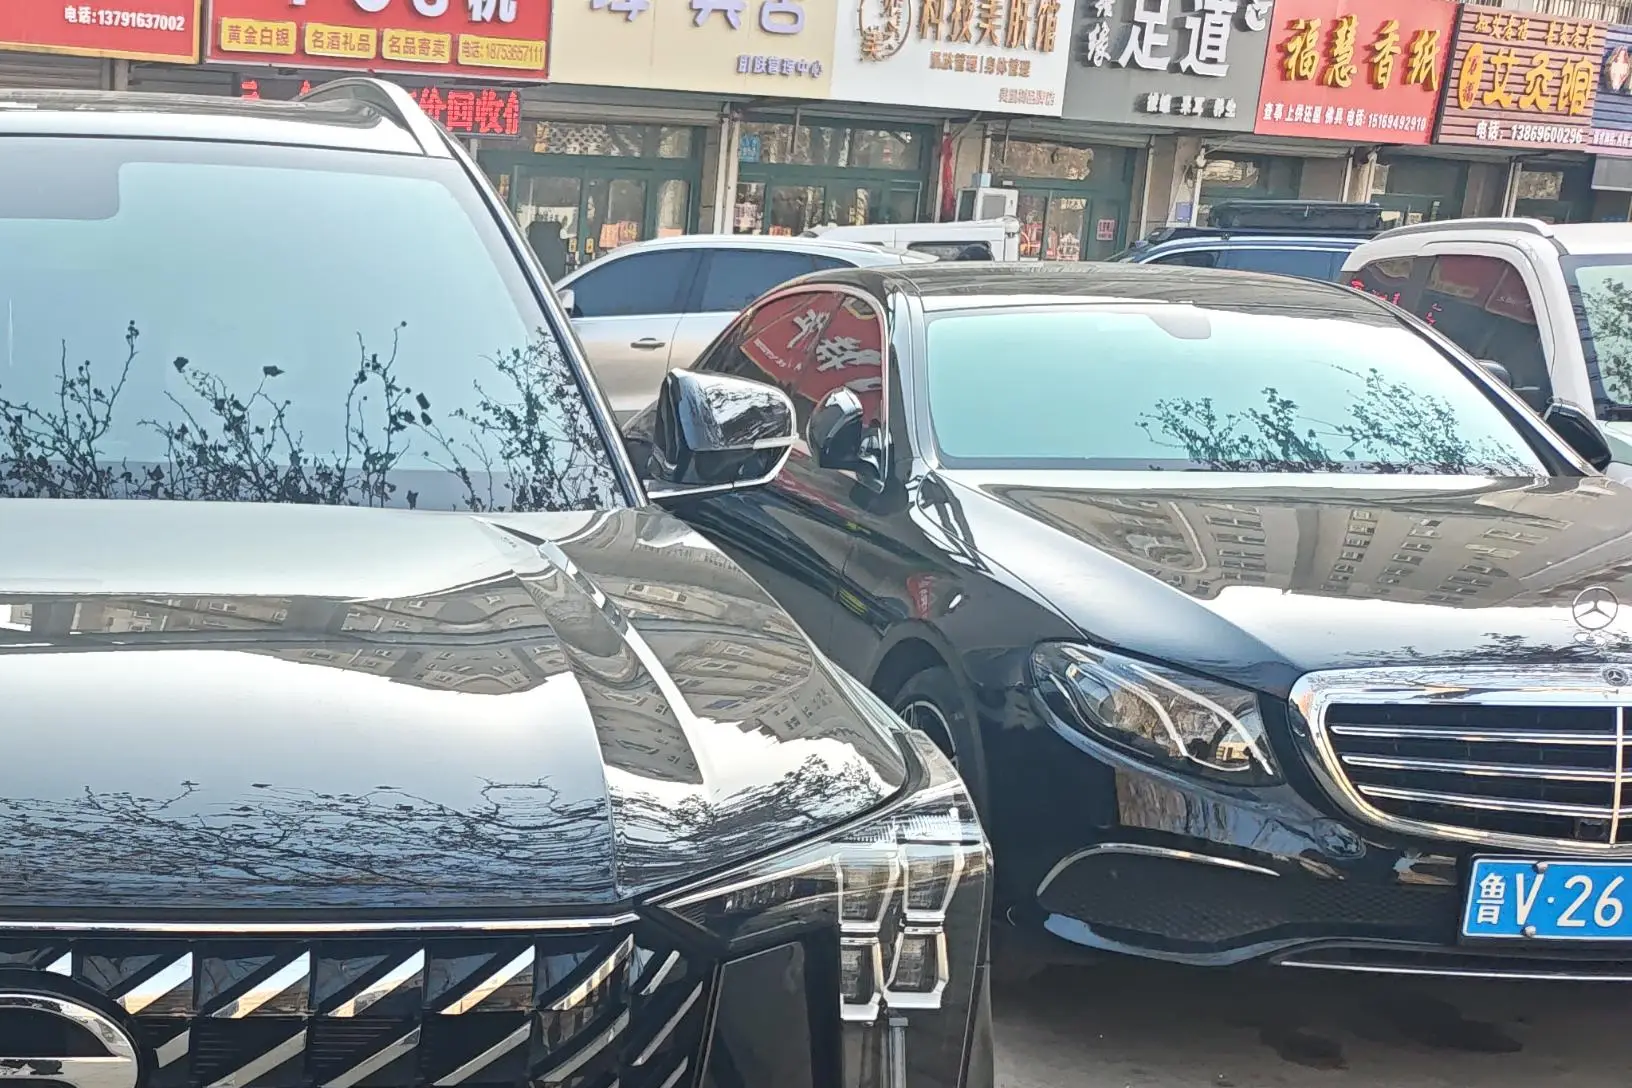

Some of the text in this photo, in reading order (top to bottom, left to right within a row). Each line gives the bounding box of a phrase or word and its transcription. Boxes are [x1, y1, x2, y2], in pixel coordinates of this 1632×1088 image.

[64, 5, 185, 31] 电话:13791637002
[227, 25, 289, 47] 黄金白银
[311, 30, 371, 53] 名酒礼品
[388, 35, 446, 58] 名品寄卖
[1118, 0, 1237, 77] 足道
[1282, 14, 1441, 91] 福慧香纸
[1482, 48, 1594, 115] 艾灸馆
